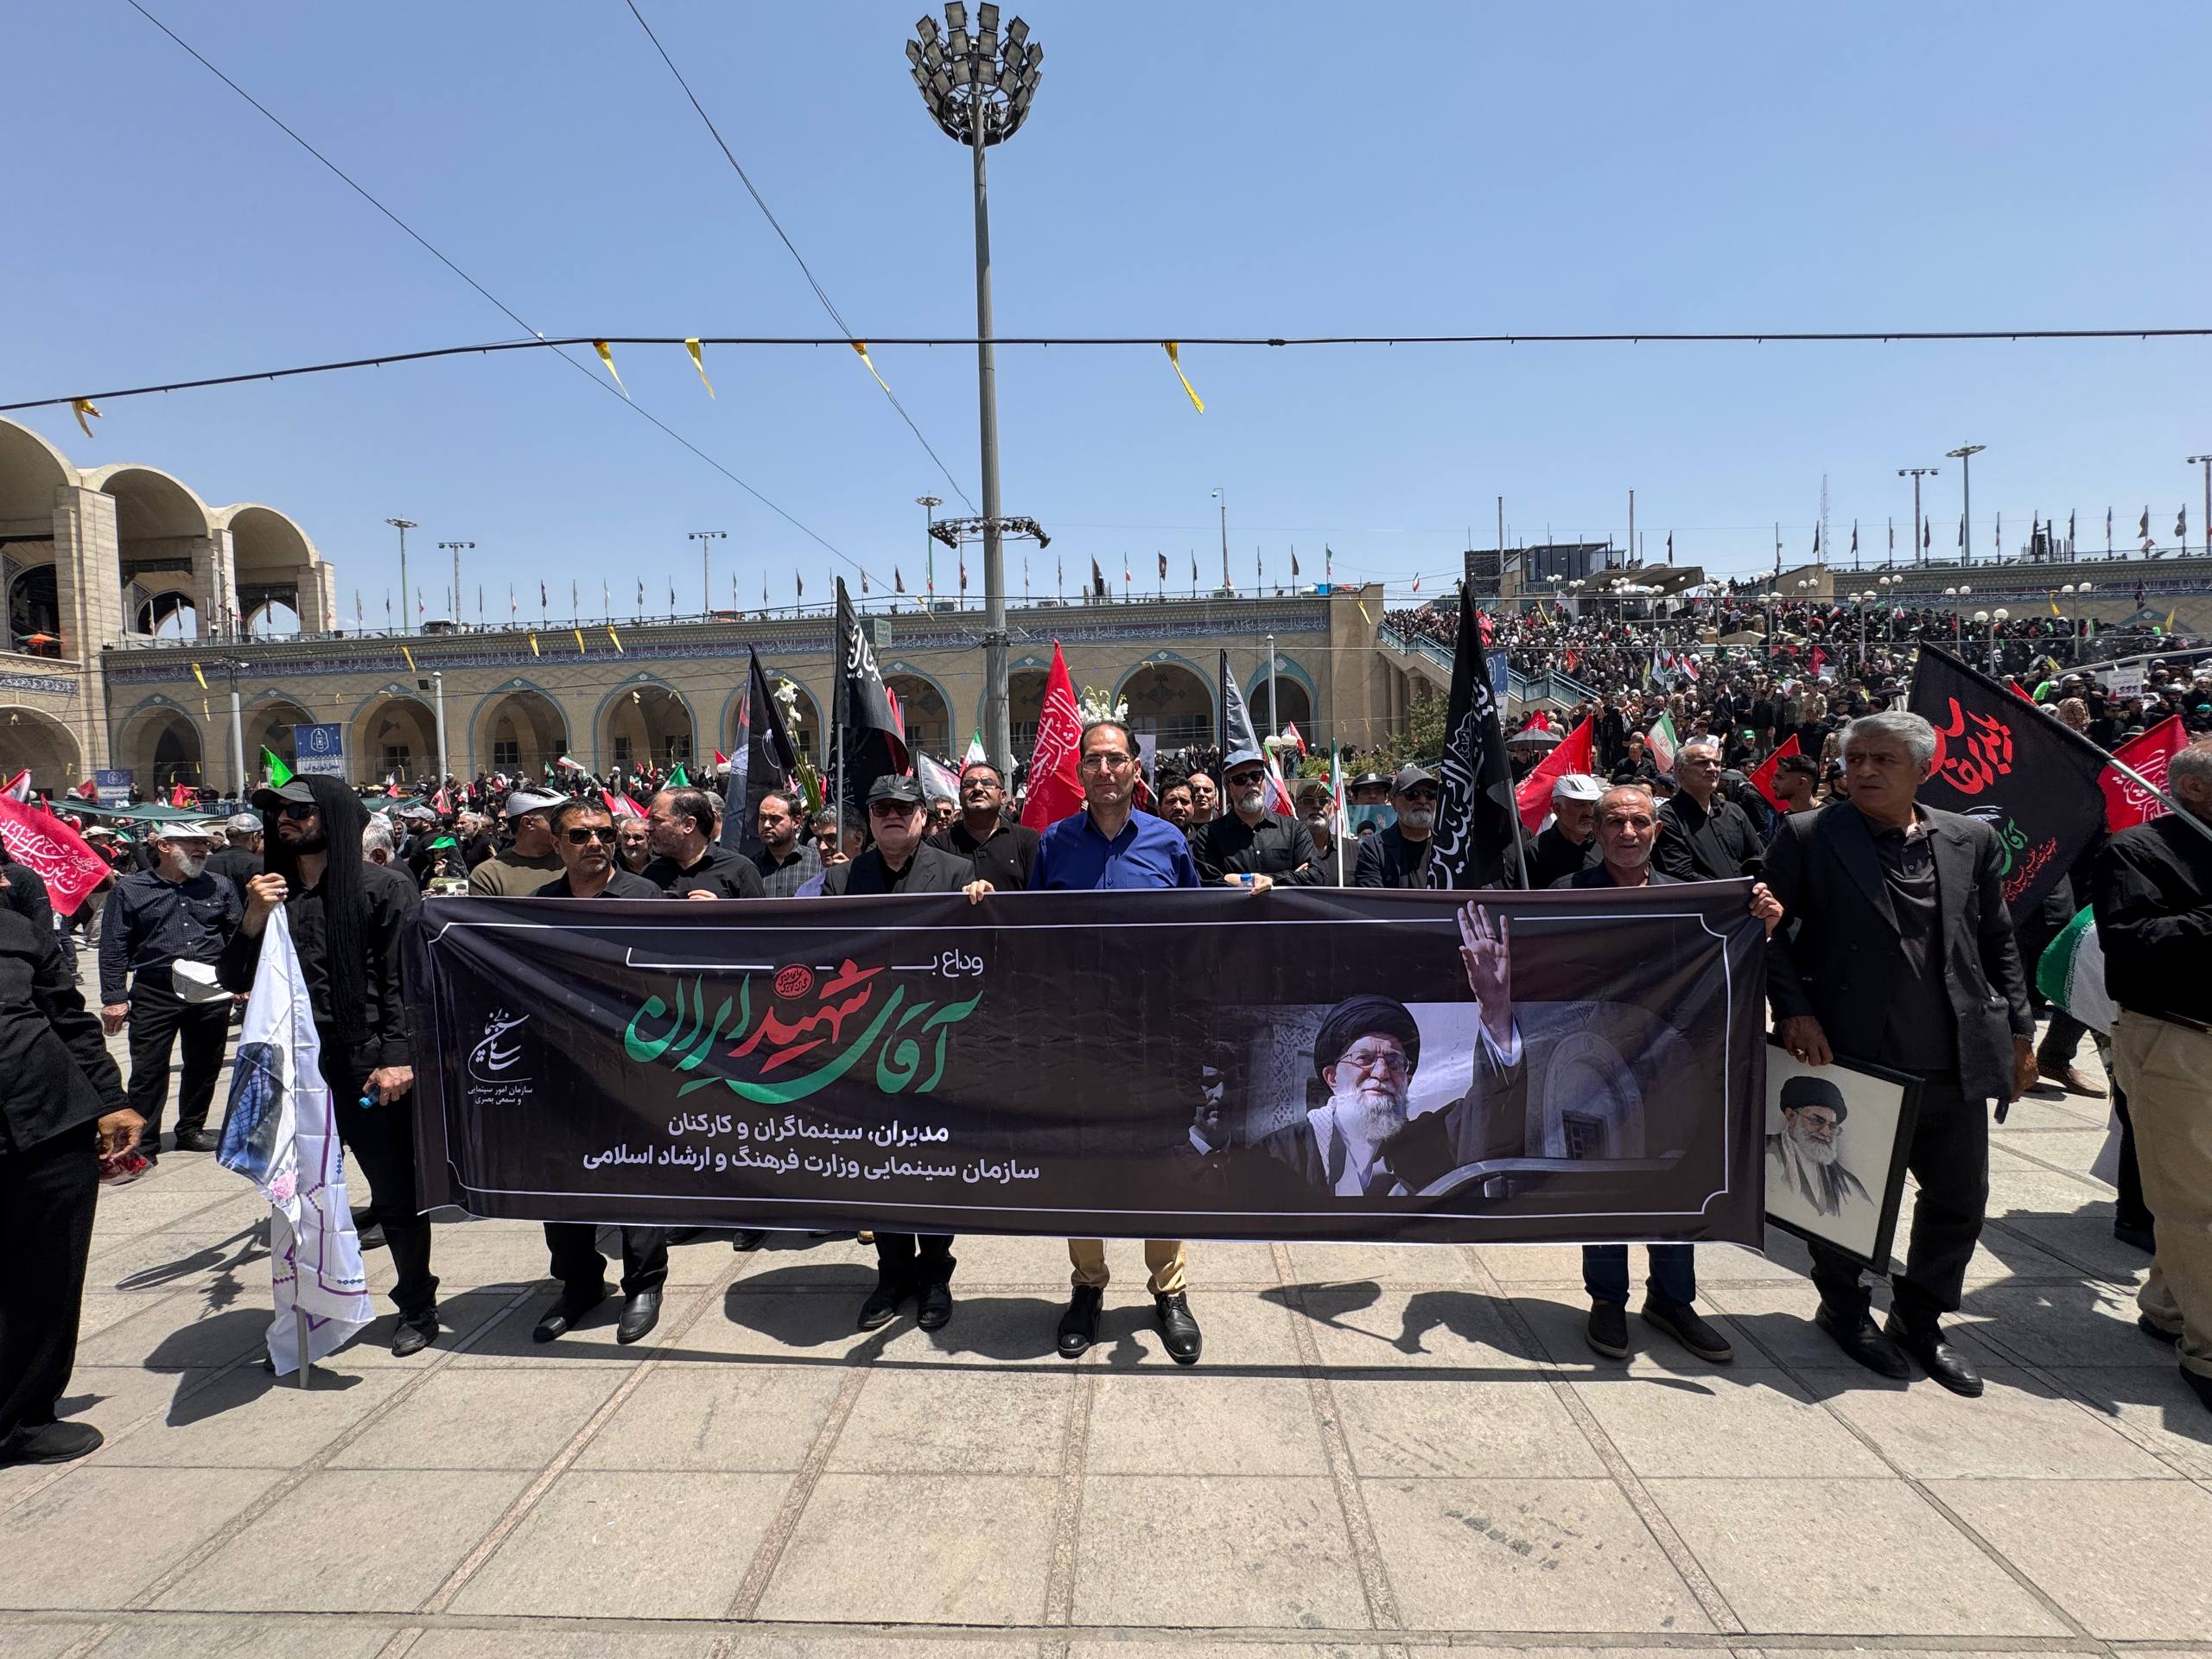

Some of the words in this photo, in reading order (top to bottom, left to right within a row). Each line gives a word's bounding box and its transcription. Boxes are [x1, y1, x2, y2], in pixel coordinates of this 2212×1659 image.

[943, 948, 985, 977] وداع
[726, 957, 886, 1075] شهید
[624, 971, 750, 1098] ایران
[725, 983, 983, 1104] آقای
[494, 1084, 507, 1096] امور
[508, 1084, 533, 1096] سازمان
[668, 1112, 733, 1138] کارکنان
[737, 1122, 749, 1141] و
[753, 1115, 863, 1145] سینماگران
[868, 1120, 949, 1147] مدیران،
[582, 1143, 653, 1170] اسلامی
[658, 1144, 710, 1172] ارشاد
[715, 1153, 728, 1173] و
[731, 1145, 800, 1174] فرهنگ
[804, 1154, 860, 1179] وزارت
[863, 1155, 957, 1182] سینمایی
[963, 1158, 1039, 1185] سازمان
